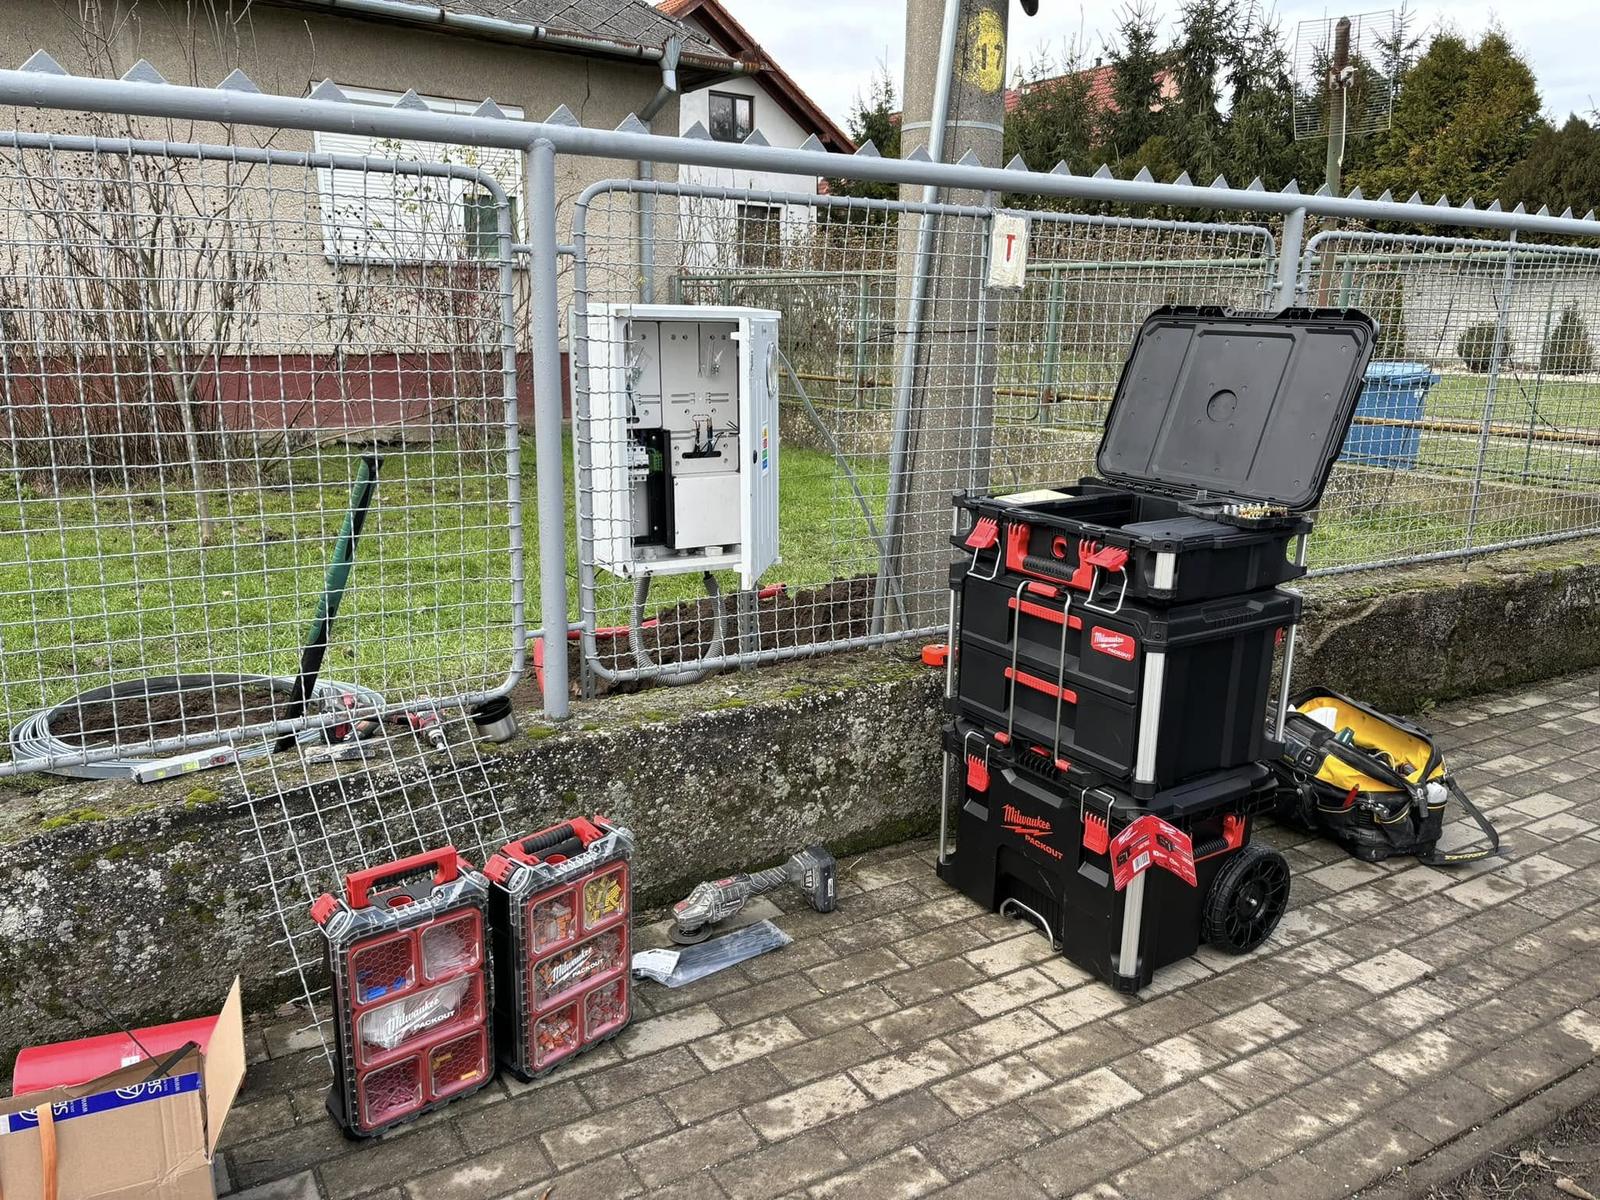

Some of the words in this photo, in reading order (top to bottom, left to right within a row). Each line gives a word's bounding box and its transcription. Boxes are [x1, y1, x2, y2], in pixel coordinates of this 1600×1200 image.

[976, 43, 1004, 71] 17
[1094, 632, 1124, 643] Milwaukee
[1002, 804, 1051, 829] Milwaukee
[1025, 835, 1063, 859] PACKOUT
[385, 998, 440, 1034] Milwaukee
[413, 1010, 456, 1031] PACKOUT
